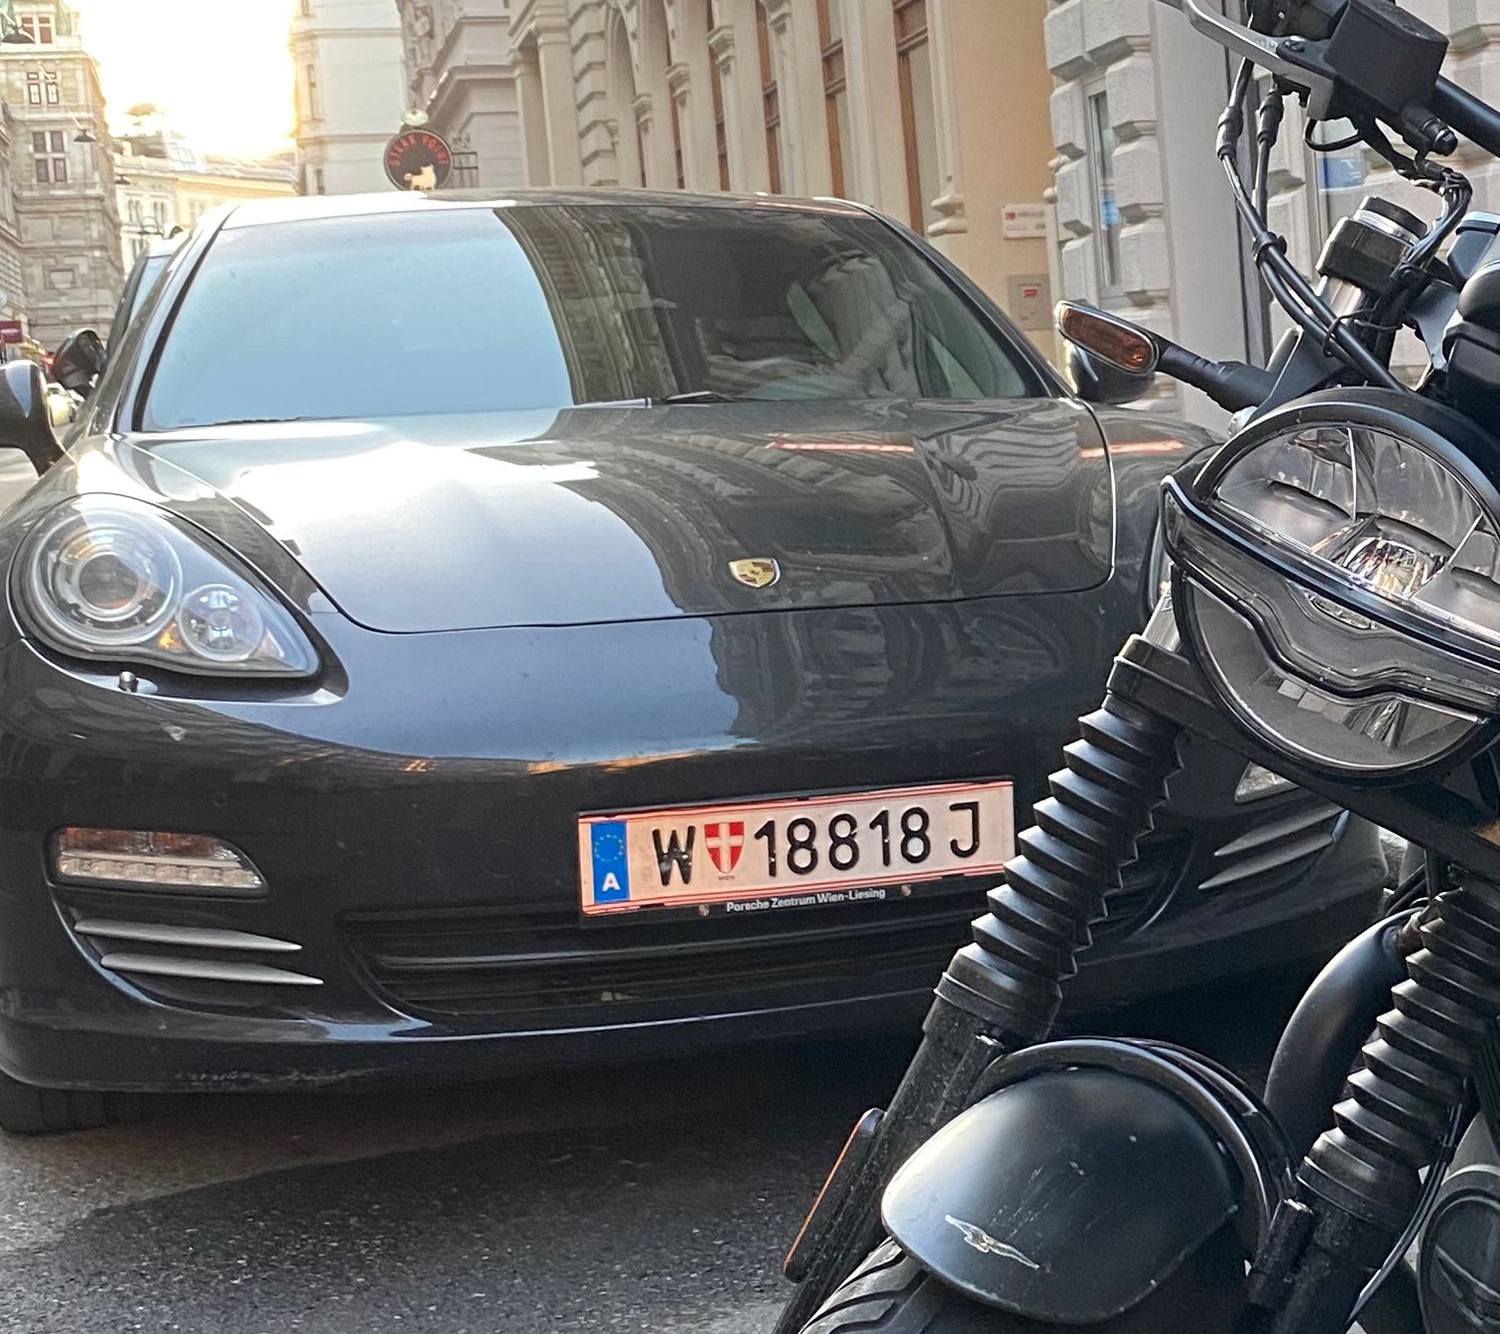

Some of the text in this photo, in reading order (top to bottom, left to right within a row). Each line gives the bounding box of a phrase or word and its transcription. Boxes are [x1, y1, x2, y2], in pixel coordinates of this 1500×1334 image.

[651, 800, 981, 887] W 18818 J
[601, 872, 622, 893] A
[726, 888, 887, 913] Porsche Zentrum Wien-Liesing
